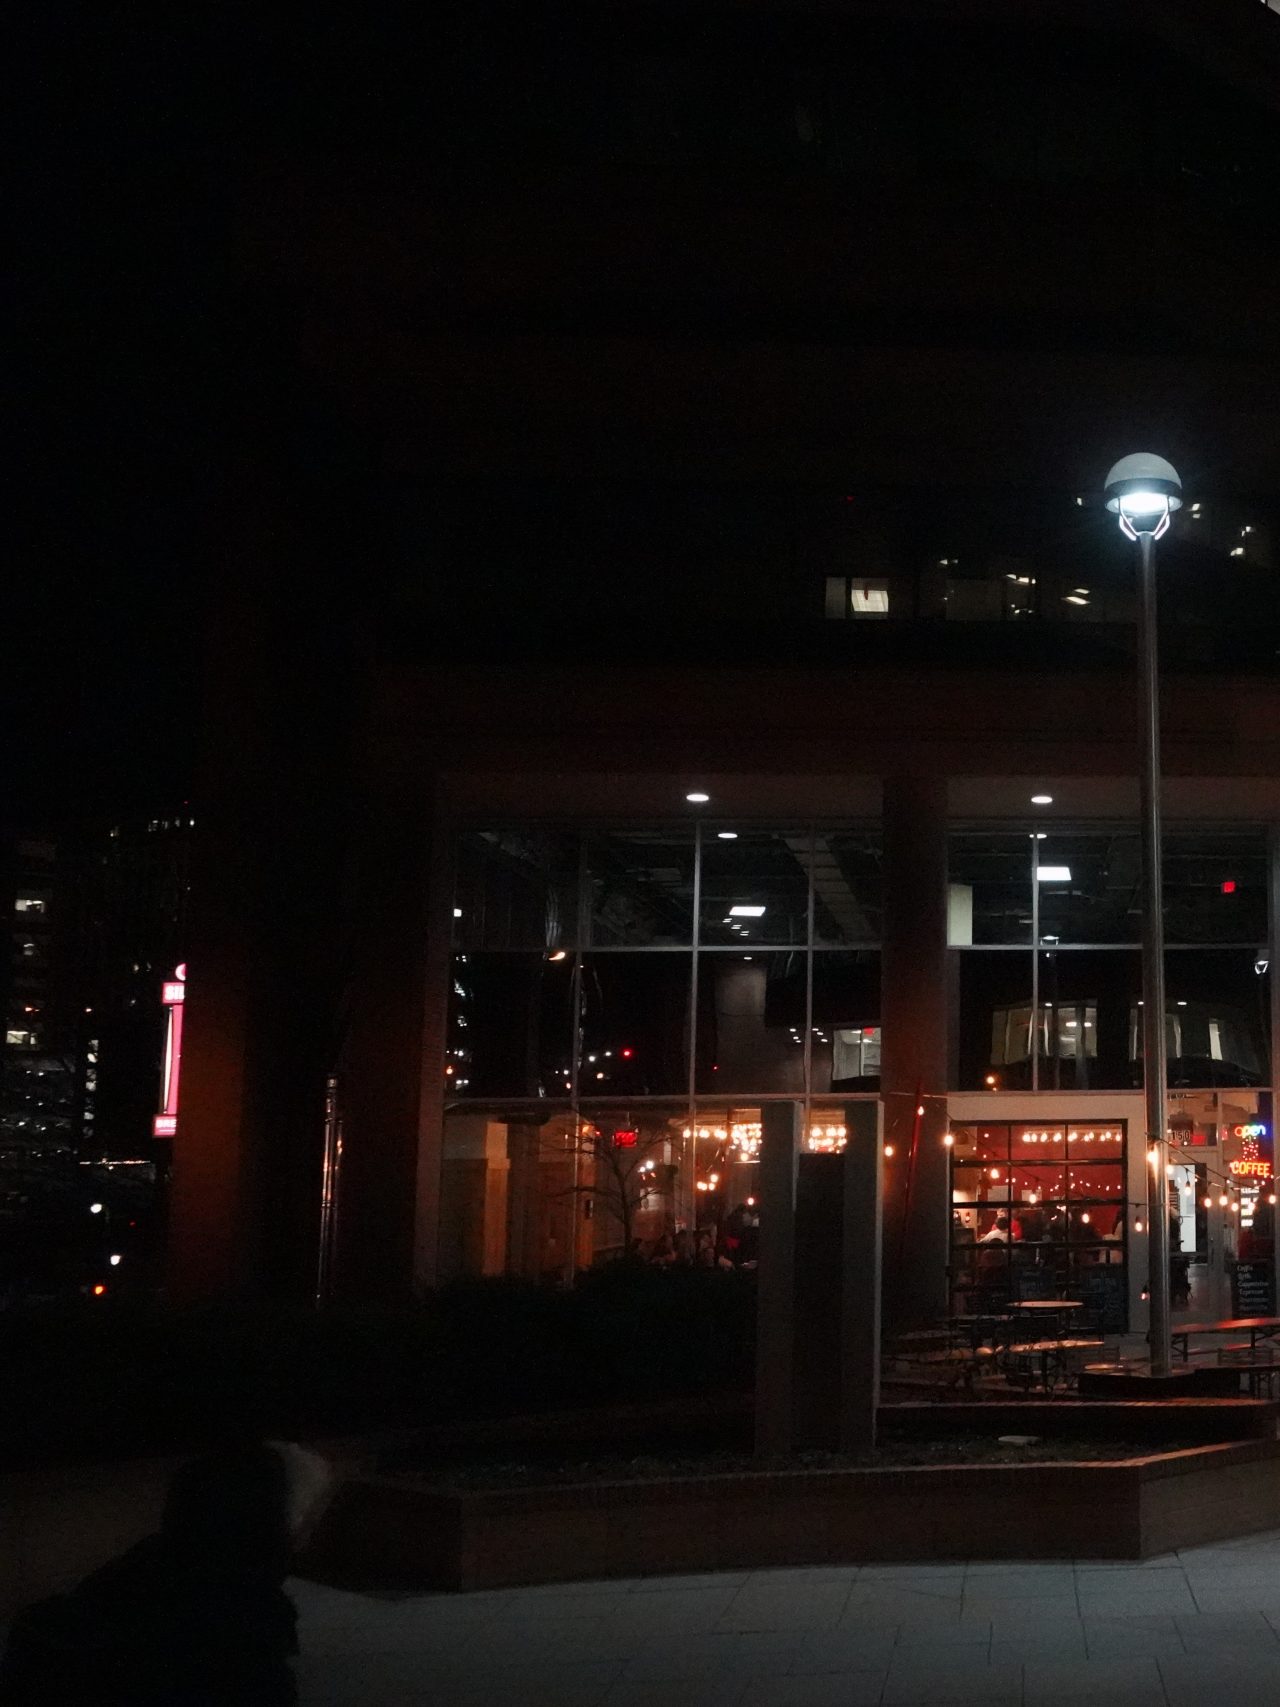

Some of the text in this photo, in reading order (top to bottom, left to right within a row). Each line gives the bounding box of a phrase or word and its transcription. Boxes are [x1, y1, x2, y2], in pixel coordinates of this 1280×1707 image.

[1172, 1130, 1191, 1141] 150
[1234, 1125, 1267, 1138] open
[1231, 1160, 1271, 1177] COFFEE
